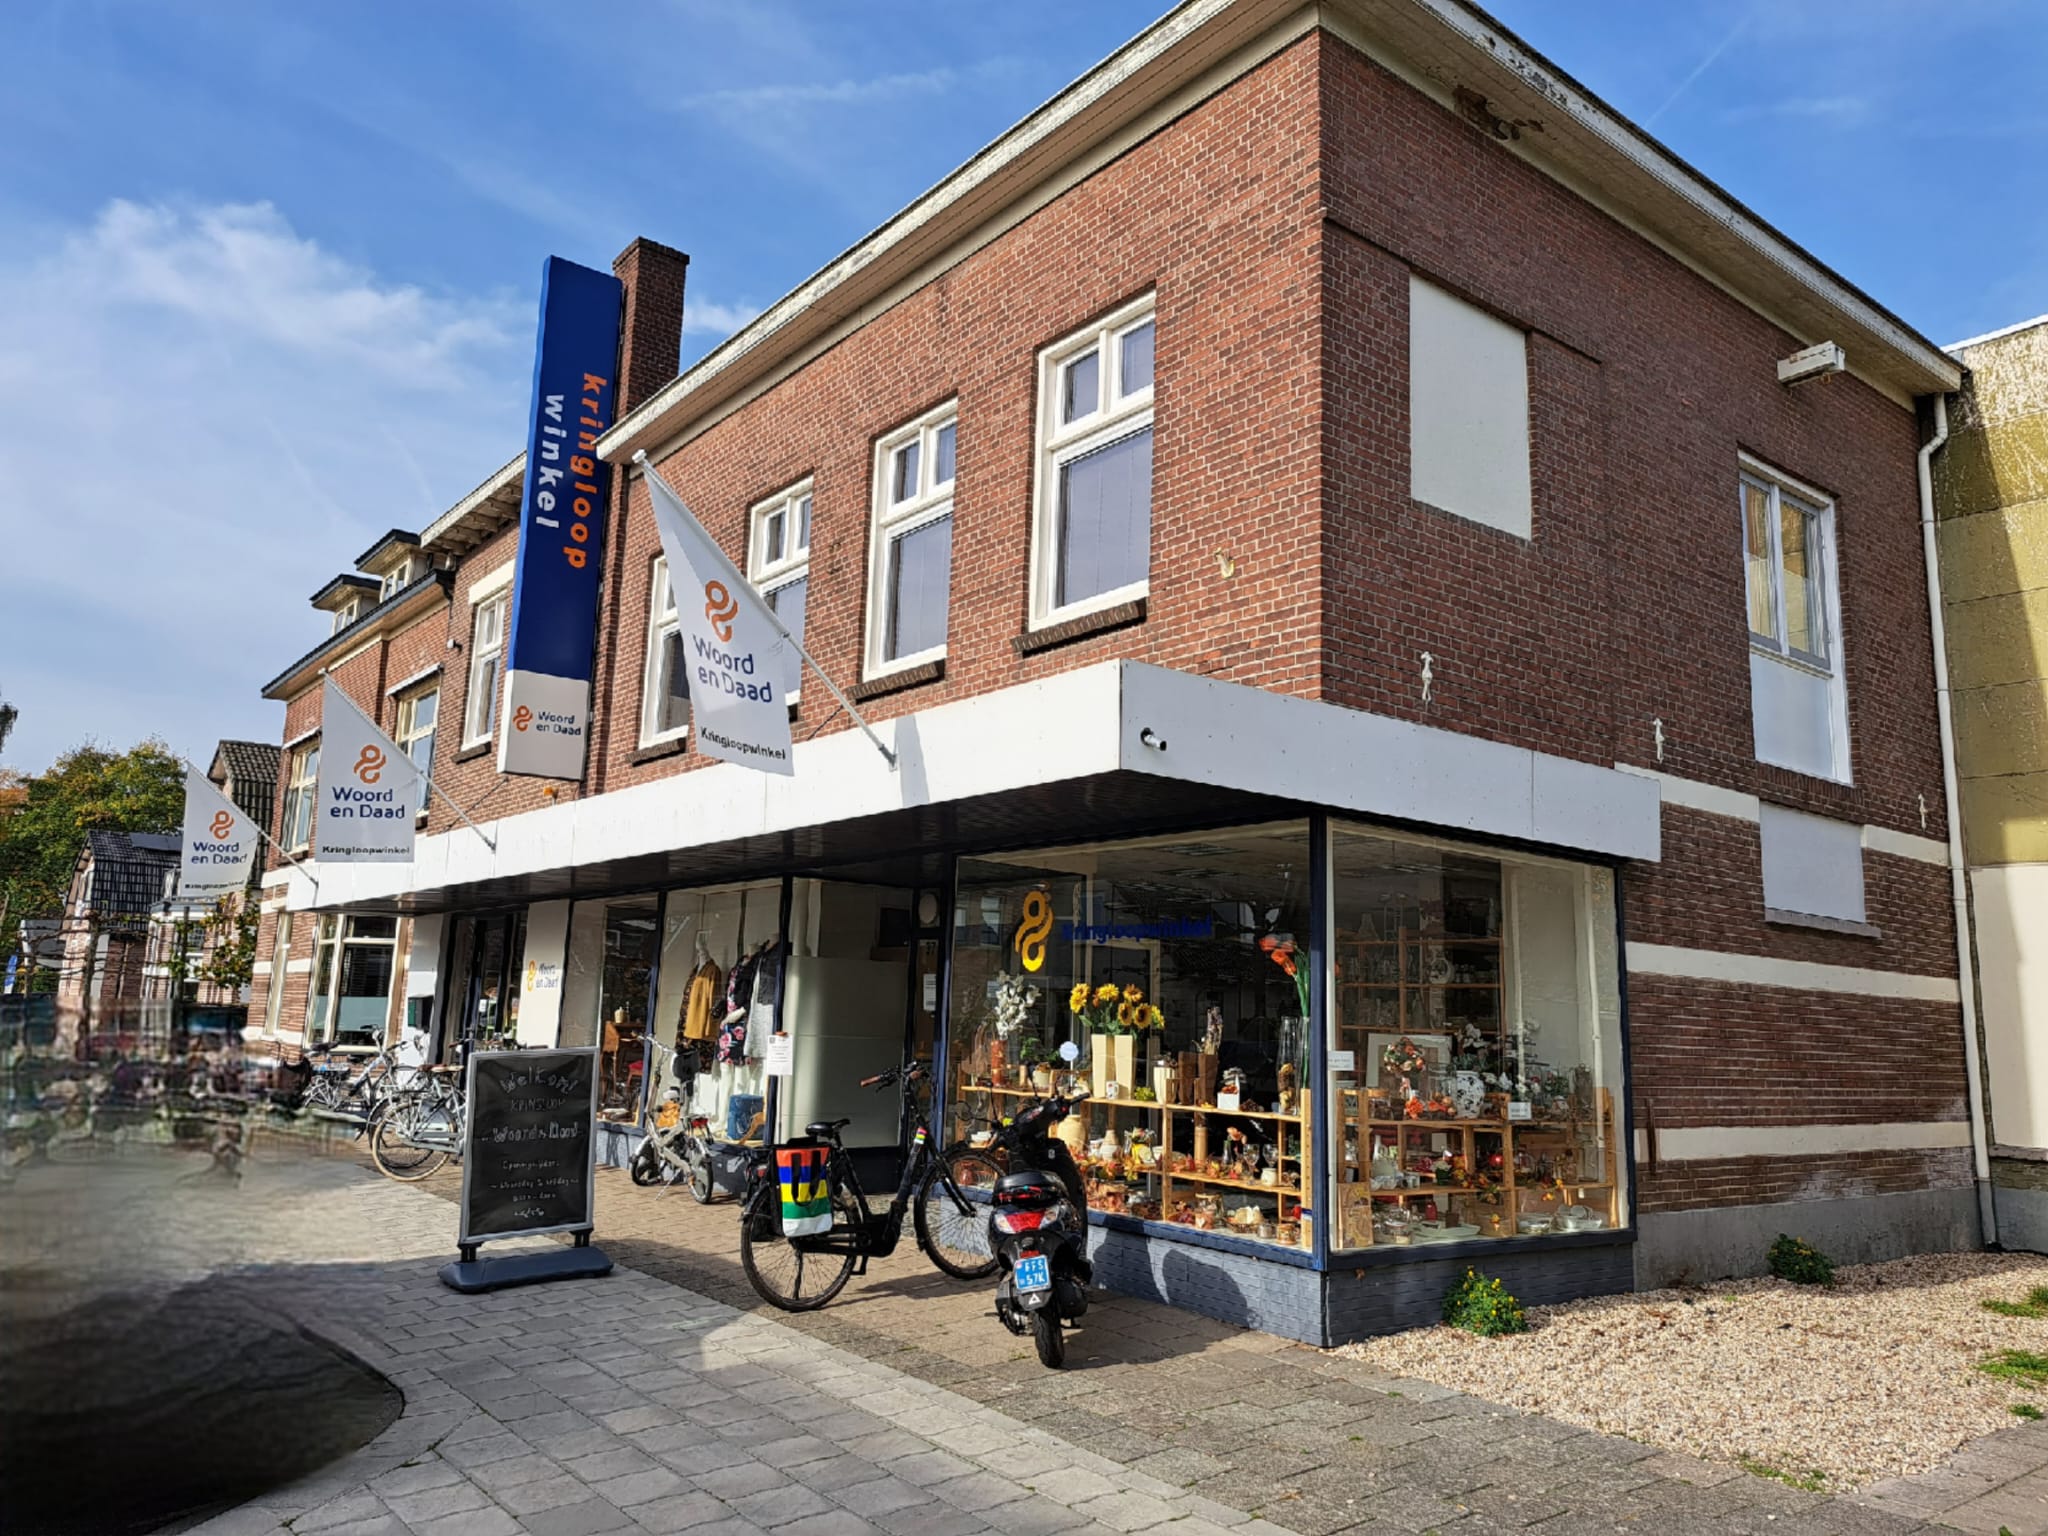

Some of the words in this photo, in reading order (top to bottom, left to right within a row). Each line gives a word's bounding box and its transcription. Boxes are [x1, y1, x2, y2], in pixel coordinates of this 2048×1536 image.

[536, 394, 567, 529] winkel
[563, 373, 608, 568] kringloop
[693, 632, 754, 676] Woord
[698, 665, 719, 690] en
[722, 672, 772, 704] Daad
[538, 711, 575, 725] Woord
[536, 724, 550, 732] en
[553, 724, 581, 736] Daad
[700, 725, 787, 761] Kringloopwinkel
[332, 786, 393, 802] Woord
[330, 806, 354, 818] en
[359, 804, 405, 819] Daad
[193, 841, 240, 853] Woord
[322, 845, 410, 856] Kringloopwinkel
[191, 855, 209, 864] en
[213, 853, 248, 864] Daad
